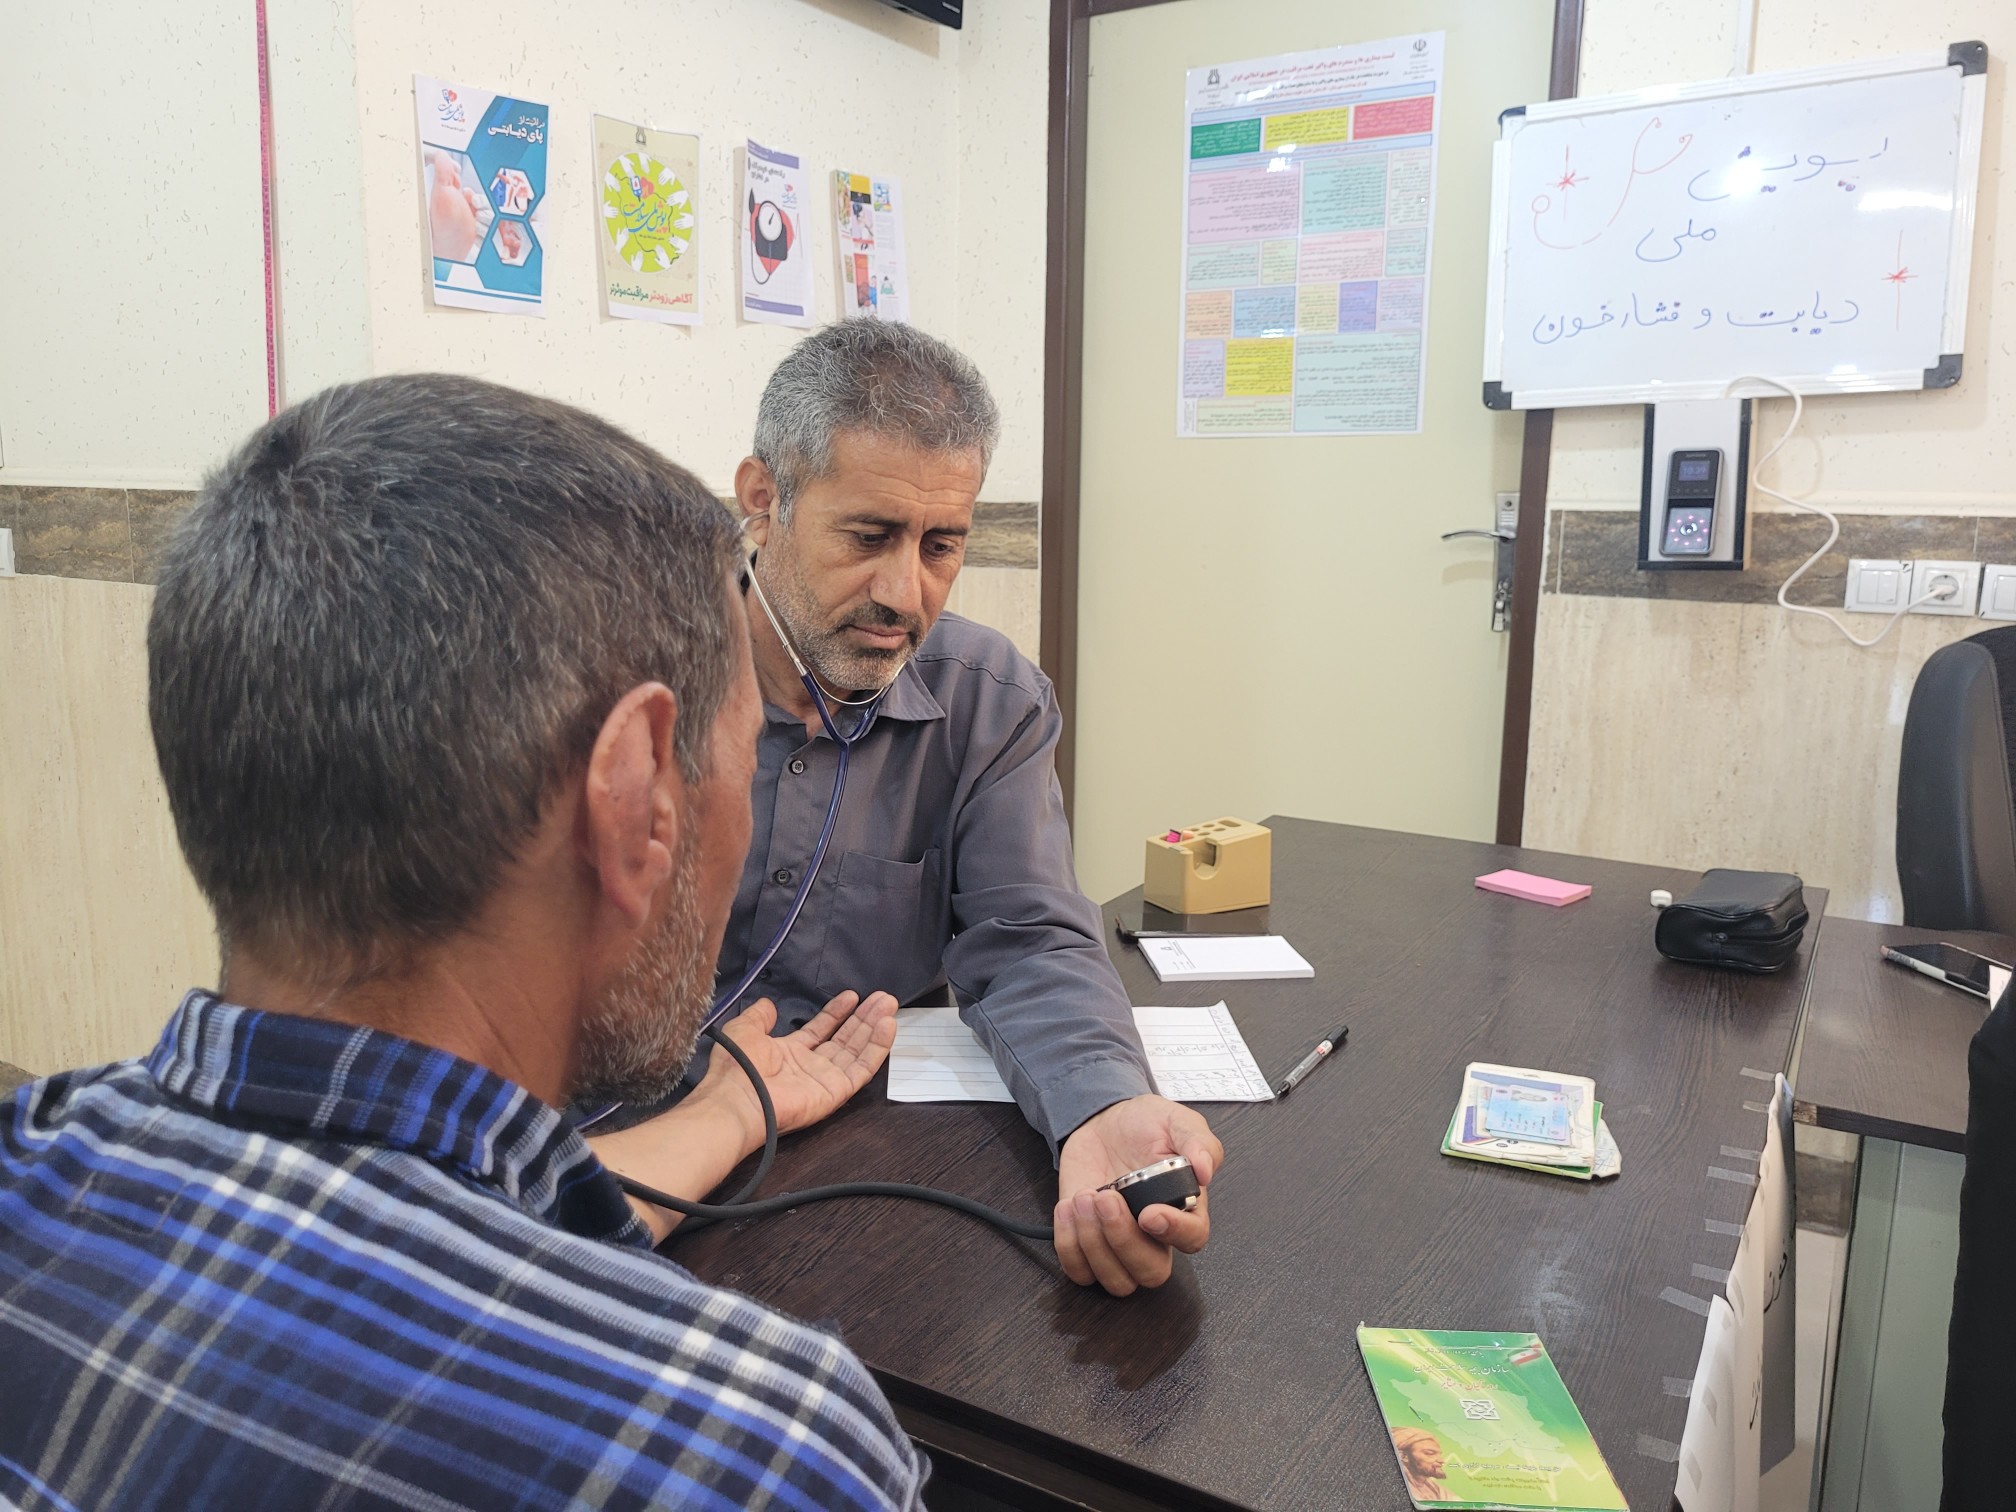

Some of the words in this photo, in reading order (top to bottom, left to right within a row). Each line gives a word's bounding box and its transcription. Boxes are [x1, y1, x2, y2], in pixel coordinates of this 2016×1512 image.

[487, 123, 528, 139] دیابتی
[527, 129, 544, 145] پای
[1636, 219, 1718, 263] ملی
[626, 286, 649, 302] مراقبت
[649, 290, 669, 304] زودتر
[668, 293, 694, 305] آگاهی
[1692, 307, 1712, 330] و
[1727, 291, 1859, 335] دیابت
[1478, 1364, 1509, 1375] سازمان
